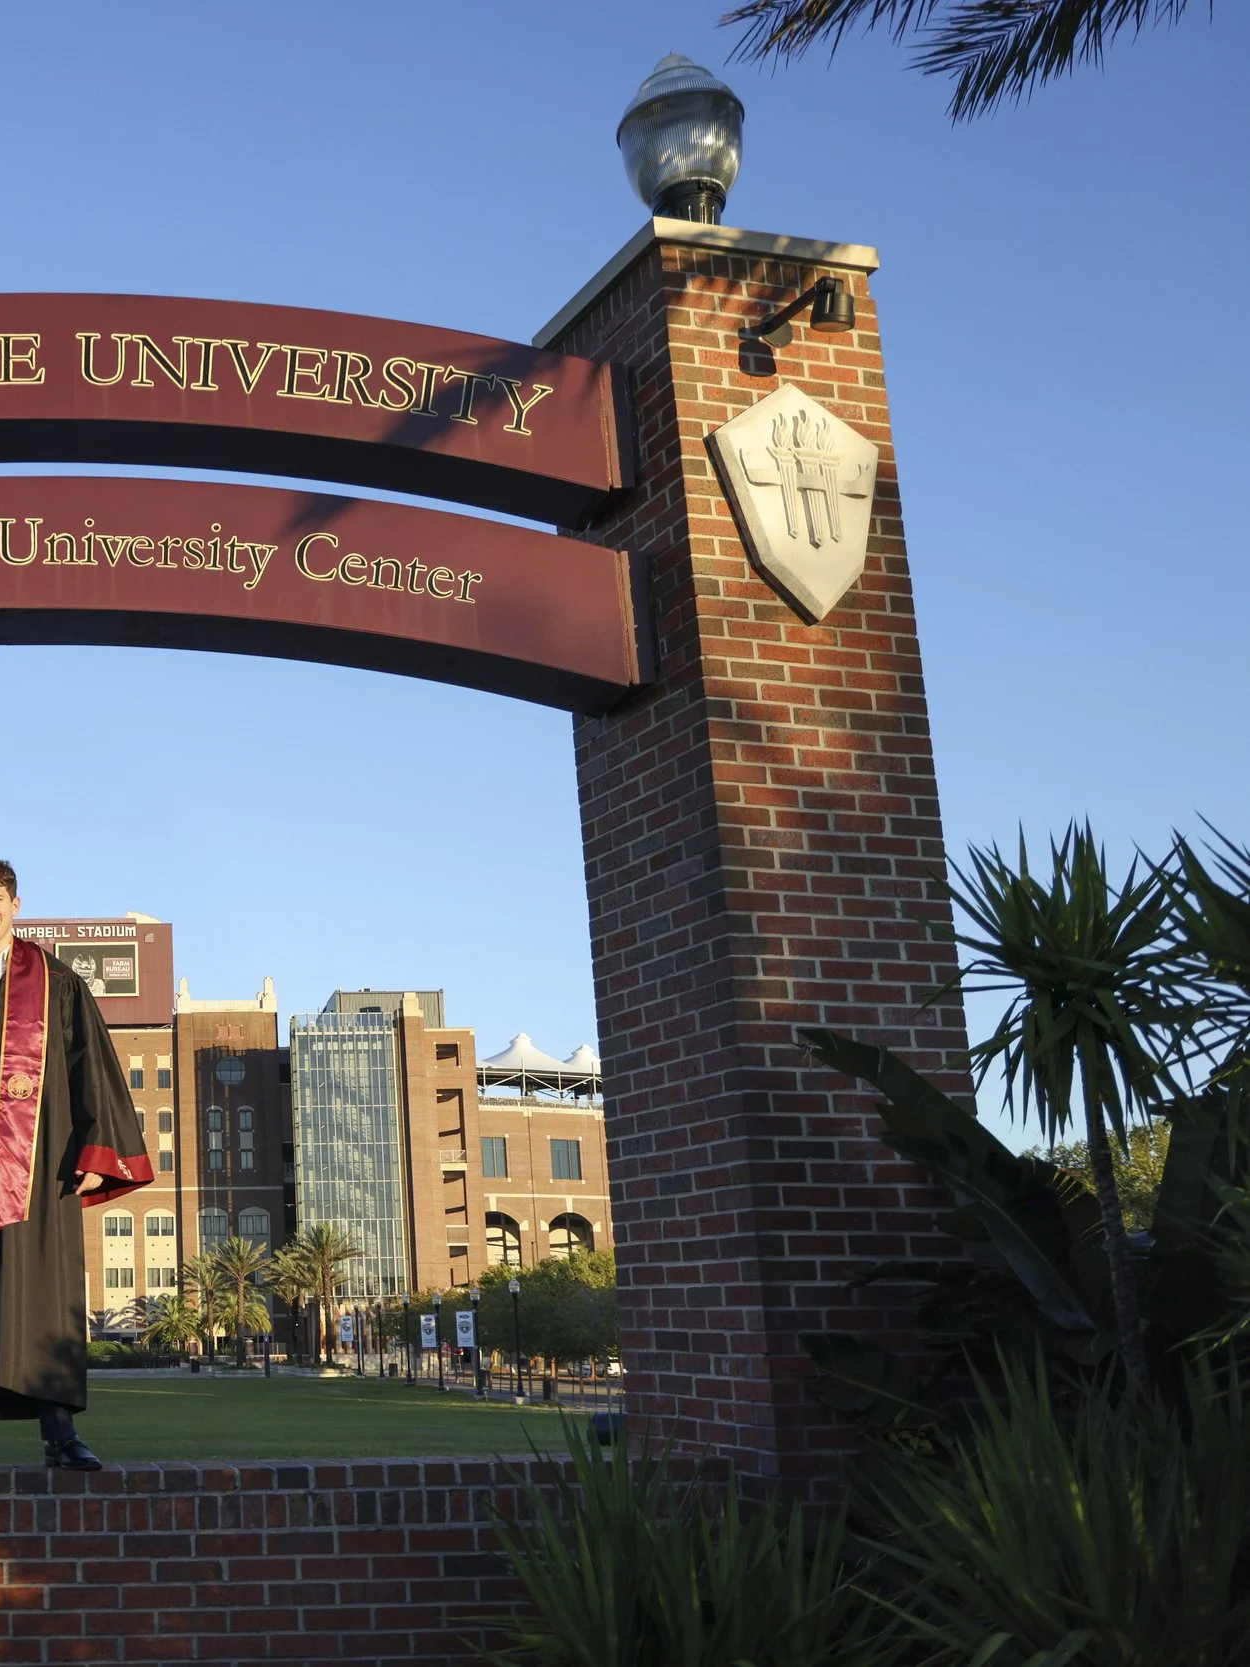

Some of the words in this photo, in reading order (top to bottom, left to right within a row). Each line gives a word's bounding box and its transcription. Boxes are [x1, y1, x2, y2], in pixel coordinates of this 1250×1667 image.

[76, 331, 554, 437] UNIVERSITY
[295, 531, 484, 605] Center
[11, 926, 70, 939] MPBELL
[77, 925, 137, 938] STADIUM
